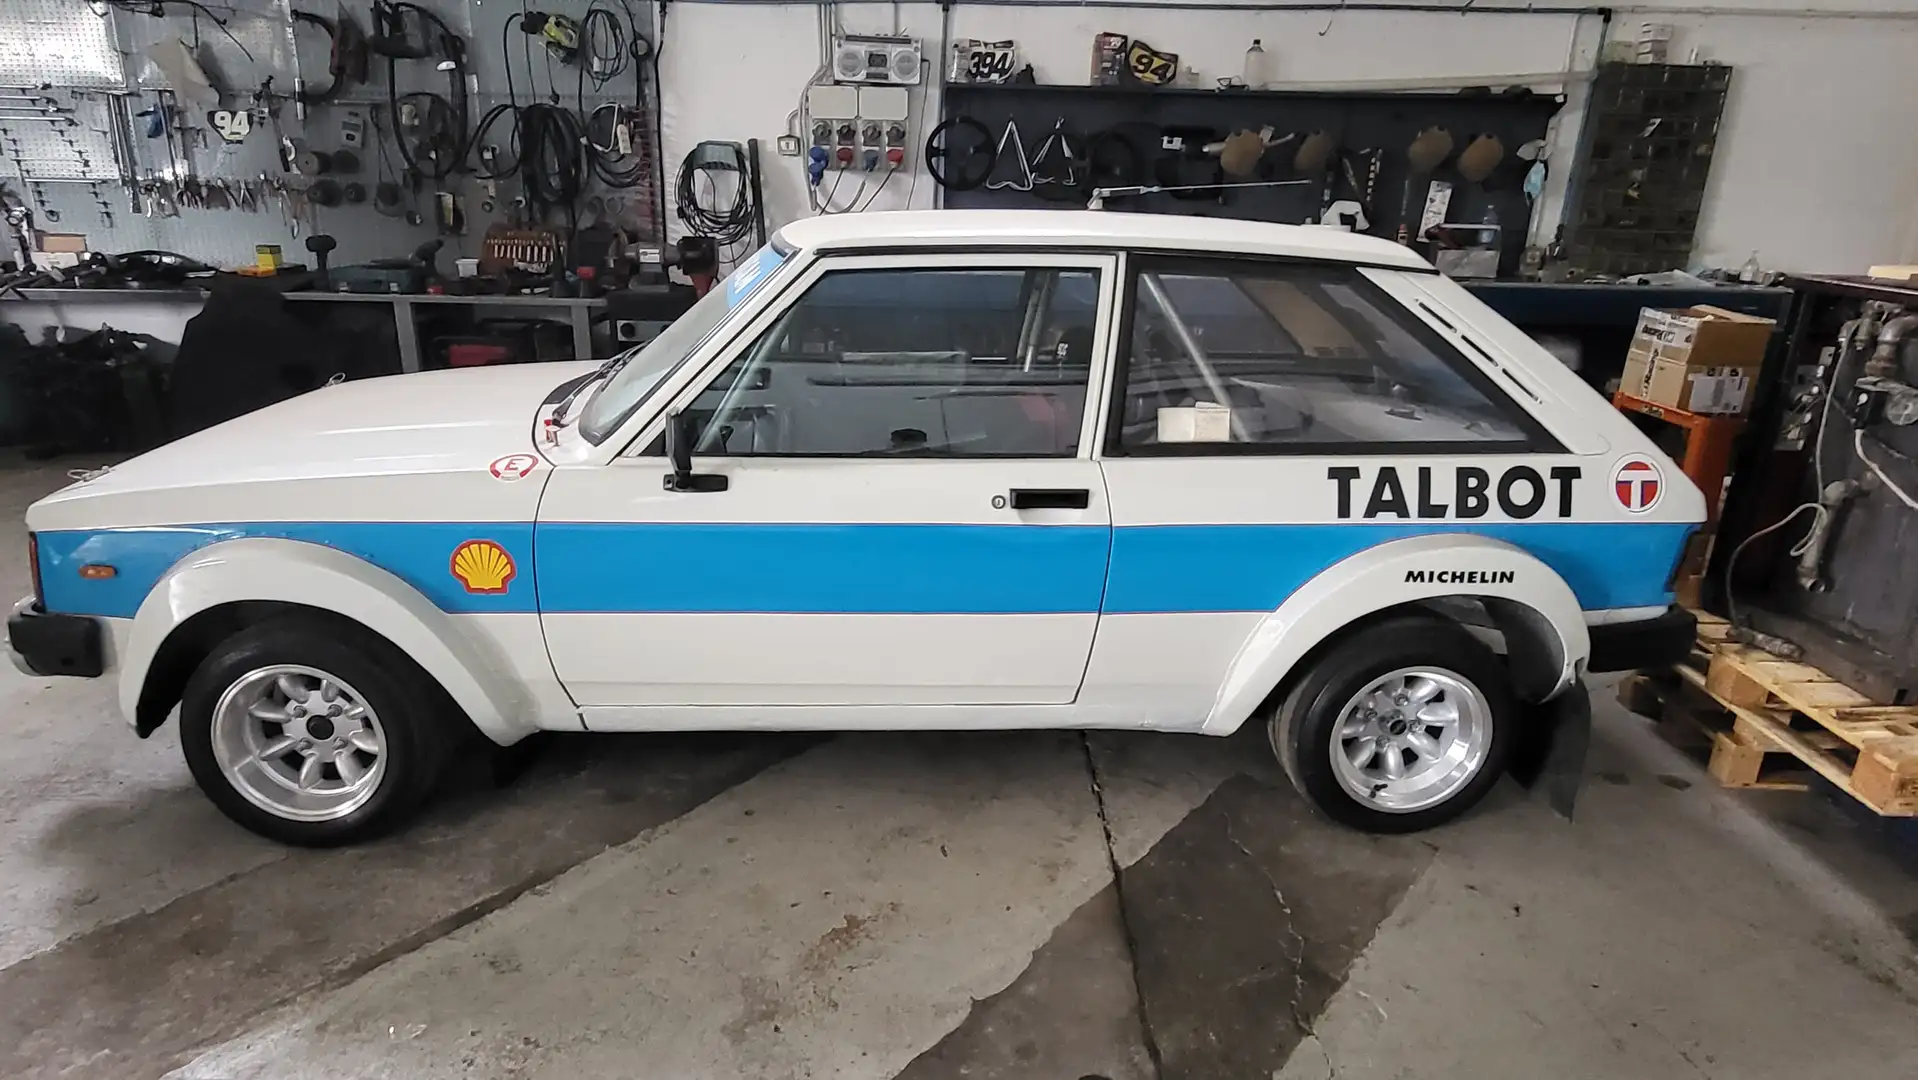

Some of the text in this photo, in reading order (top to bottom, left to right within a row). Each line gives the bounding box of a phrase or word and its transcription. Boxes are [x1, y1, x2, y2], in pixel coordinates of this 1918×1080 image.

[968, 51, 1012, 79] 394
[1131, 54, 1172, 81] 94
[214, 111, 250, 140] 94
[1327, 465, 1582, 519] TALBOT
[1404, 570, 1515, 583] MICHELIN
